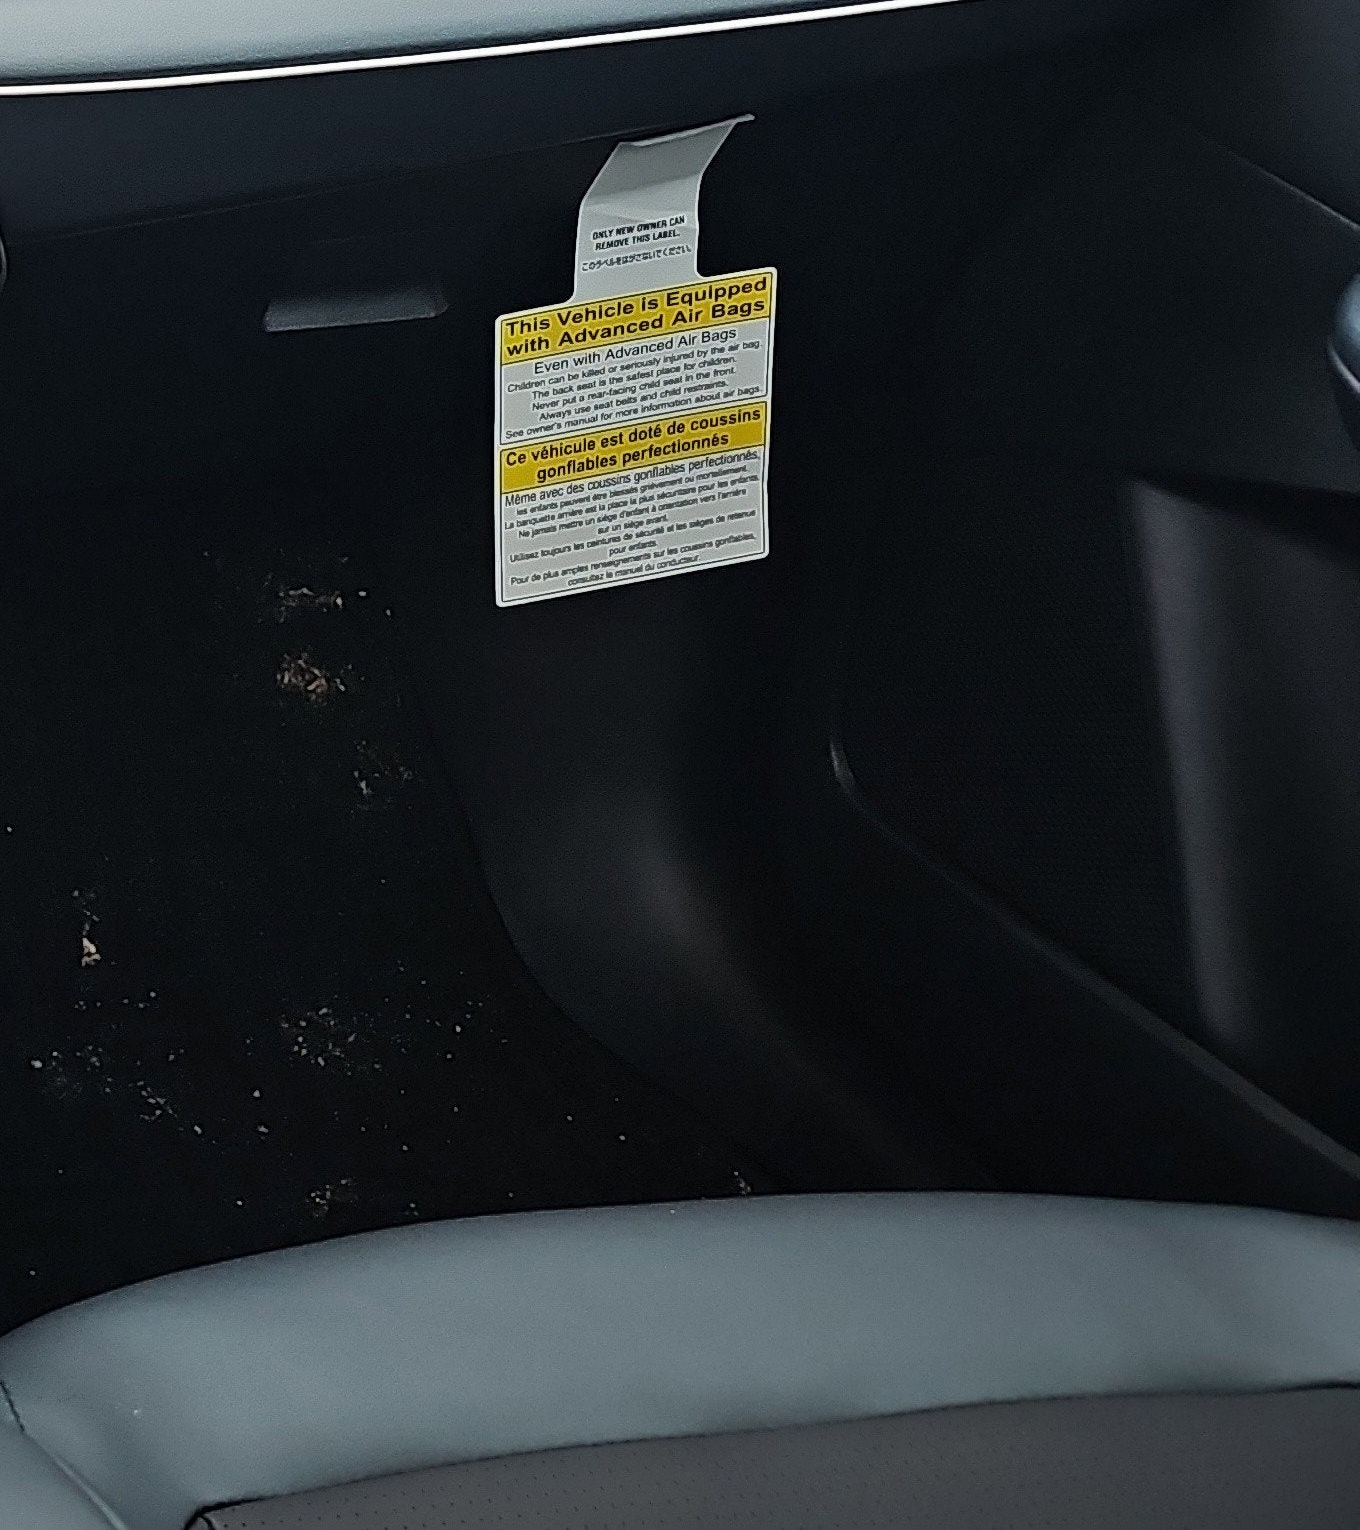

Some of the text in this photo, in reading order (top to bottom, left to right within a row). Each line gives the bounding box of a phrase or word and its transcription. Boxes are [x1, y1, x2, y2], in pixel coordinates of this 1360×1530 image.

[593, 215, 684, 240] ONLY NEW OWNER CAN
[595, 229, 680, 251] REMOVE THIS LABEL.
[506, 275, 766, 336] This Vehicle is Equipped
[507, 299, 765, 356] with Advanced Air Bags
[508, 379, 545, 392] Children
[548, 376, 564, 384] can
[568, 372, 579, 381] be
[582, 367, 605, 378] killed
[620, 358, 660, 371] seriously
[664, 350, 694, 363] injured
[697, 349, 708, 358] by
[711, 346, 725, 354] the
[728, 343, 740, 351] air
[743, 340, 762, 349] bag.
[535, 329, 736, 373] Even with Advanced Air Bags
[532, 389, 549, 399] The
[553, 384, 574, 395] back
[577, 380, 596, 390] seat
[609, 376, 623, 384] the
[626, 369, 653, 381] safest
[656, 366, 680, 377] place
[684, 363, 695, 371] for
[532, 400, 558, 410] Never
[562, 395, 576, 406] put
[588, 386, 636, 400] rear-facing
[639, 379, 660, 390] child
[663, 375, 682, 386] seat
[685, 374, 693, 382] in
[696, 371, 710, 380] the
[506, 430, 523, 438] See
[527, 422, 562, 434] owner's
[565, 414, 598, 427] manual
[616, 408, 638, 418] more
[641, 398, 691, 413] information
[695, 391, 720, 403] about
[723, 389, 735, 398] air
[539, 409, 571, 420] Always
[575, 406, 590, 414] use
[594, 400, 613, 410] seat
[616, 396, 637, 406] belts
[640, 392, 656, 402] and
[660, 387, 681, 398] child
[507, 408, 760, 466] Ce véhicule est doté de coussins
[537, 432, 728, 483] gonflables perfectionnés
[506, 493, 536, 506] Même
[540, 488, 563, 499] avec
[567, 483, 584, 494] des
[588, 474, 630, 490] coussins
[634, 464, 685, 483] gonflables
[609, 546, 626, 556] pour
[511, 576, 529, 585] Pour
[532, 573, 540, 581] de
[543, 570, 559, 580] plus
